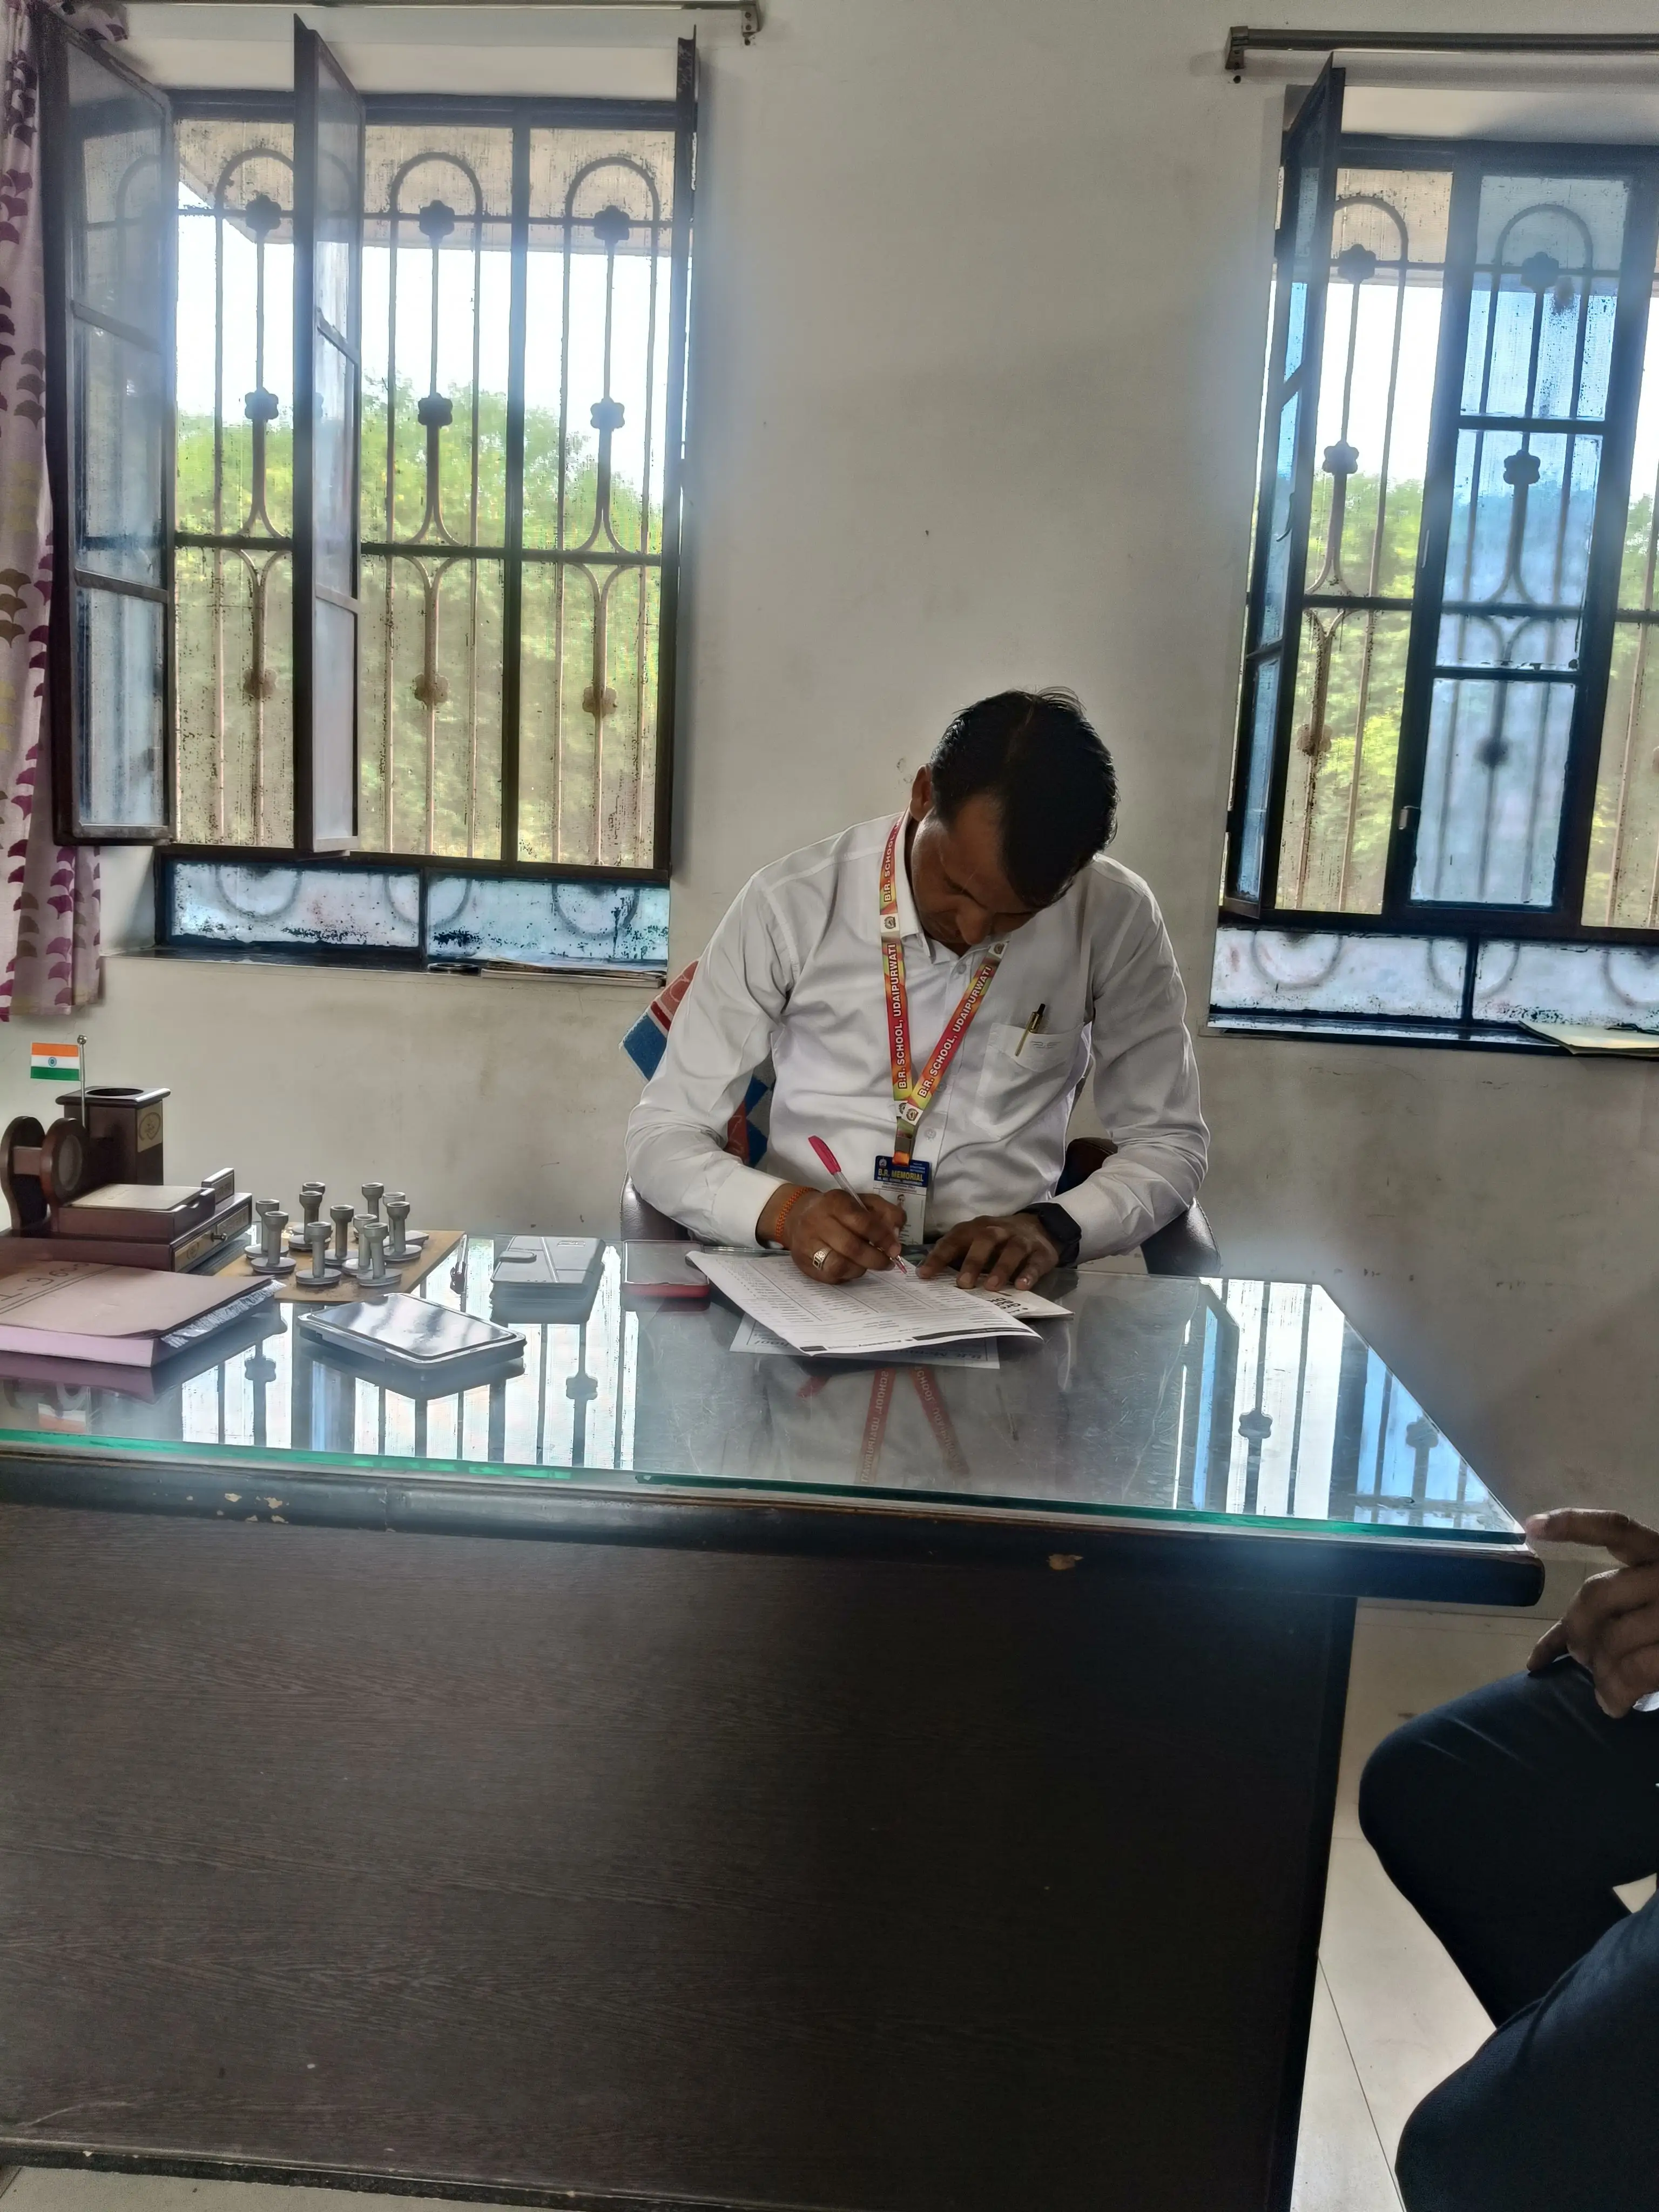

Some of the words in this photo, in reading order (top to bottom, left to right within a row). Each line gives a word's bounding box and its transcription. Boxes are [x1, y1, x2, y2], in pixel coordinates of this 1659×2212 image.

[885, 830, 898, 878] SCHOOL,
[884, 879, 892, 902] B.R.
[888, 944, 901, 1017] UDAIPURWATI
[894, 1019, 906, 1065] SCHOOL,
[918, 1077, 934, 1098] B.R.
[930, 1035, 957, 1075] SCHOOL,
[953, 966, 992, 1033] UDAIPURWATI
[898, 1067, 907, 1089] B.R.
[891, 1170, 924, 1182] MEMORIAL
